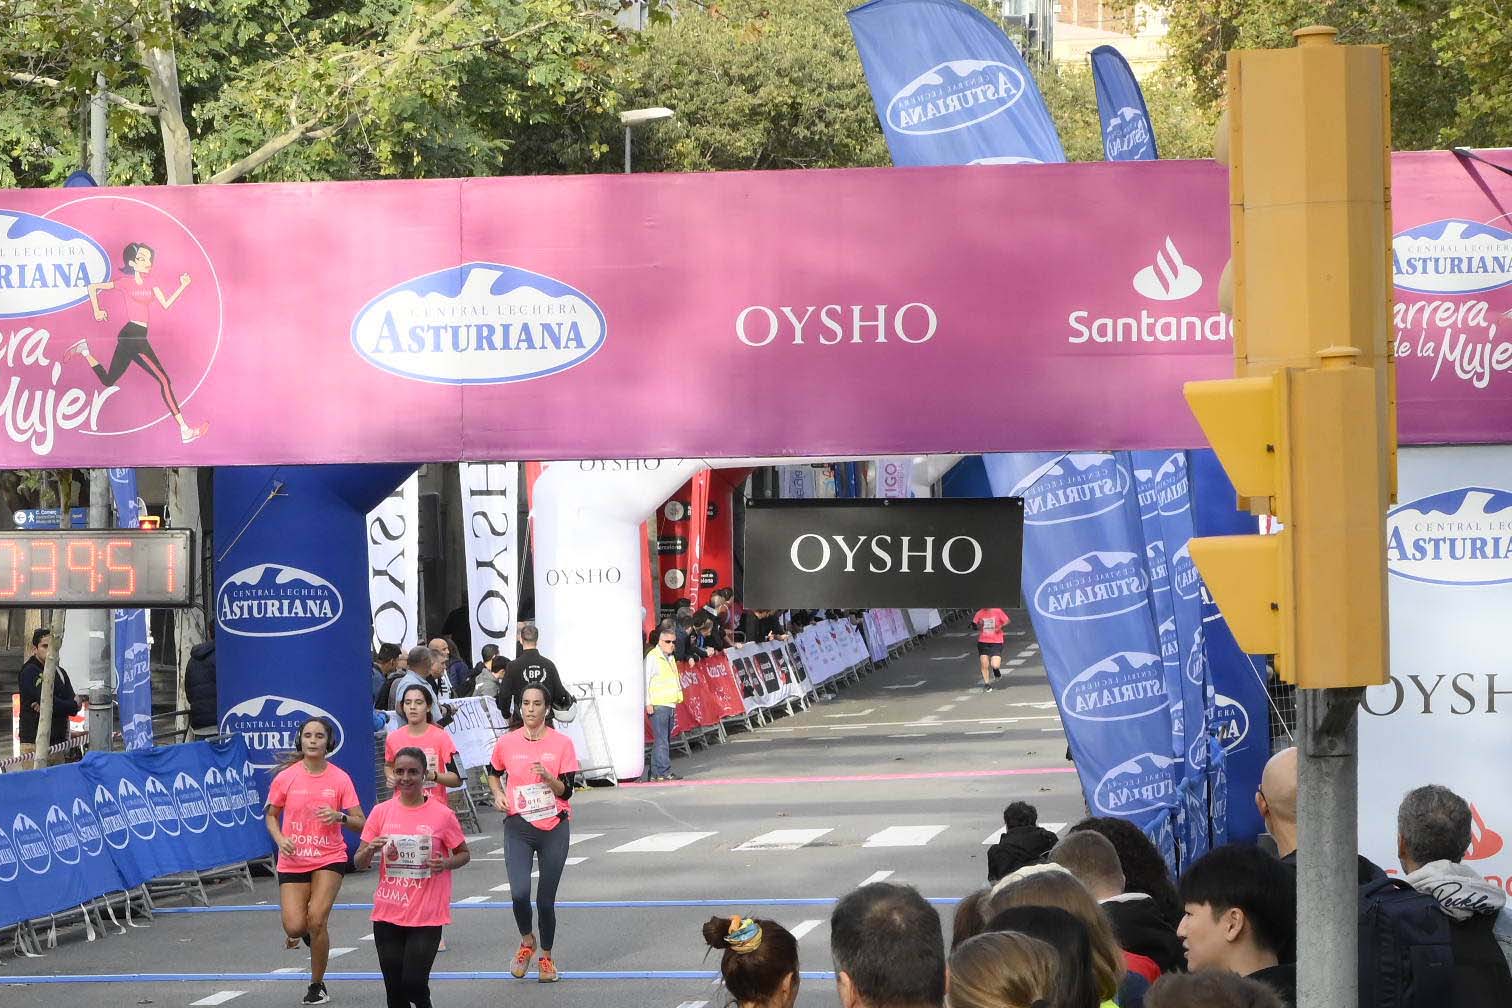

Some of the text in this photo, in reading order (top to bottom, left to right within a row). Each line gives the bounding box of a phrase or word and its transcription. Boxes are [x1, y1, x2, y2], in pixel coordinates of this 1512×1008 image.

[13, 245, 86, 257] LECHERA
[1407, 244, 1460, 254] CENTRAL
[408, 302, 579, 317] CENTRAL LECHERA
[1394, 300, 1490, 330] arrera
[734, 301, 939, 347] OYSHO
[370, 311, 586, 355] ASTURIANA
[1417, 326, 1435, 358] la
[1430, 322, 1512, 388] Muje
[1414, 522, 1482, 533] CENTRAL
[789, 533, 983, 574] OYSHO
[546, 566, 622, 587] OYSHO
[233, 588, 329, 598] CENTRAL LECHERA
[220, 593, 334, 621] ASTURIANA
[235, 720, 277, 729] CENTRAL
[290, 821, 304, 832] TU
[291, 833, 330, 846] DORSAL
[381, 876, 423, 889] ORSAL
[376, 885, 409, 903] SUMA
